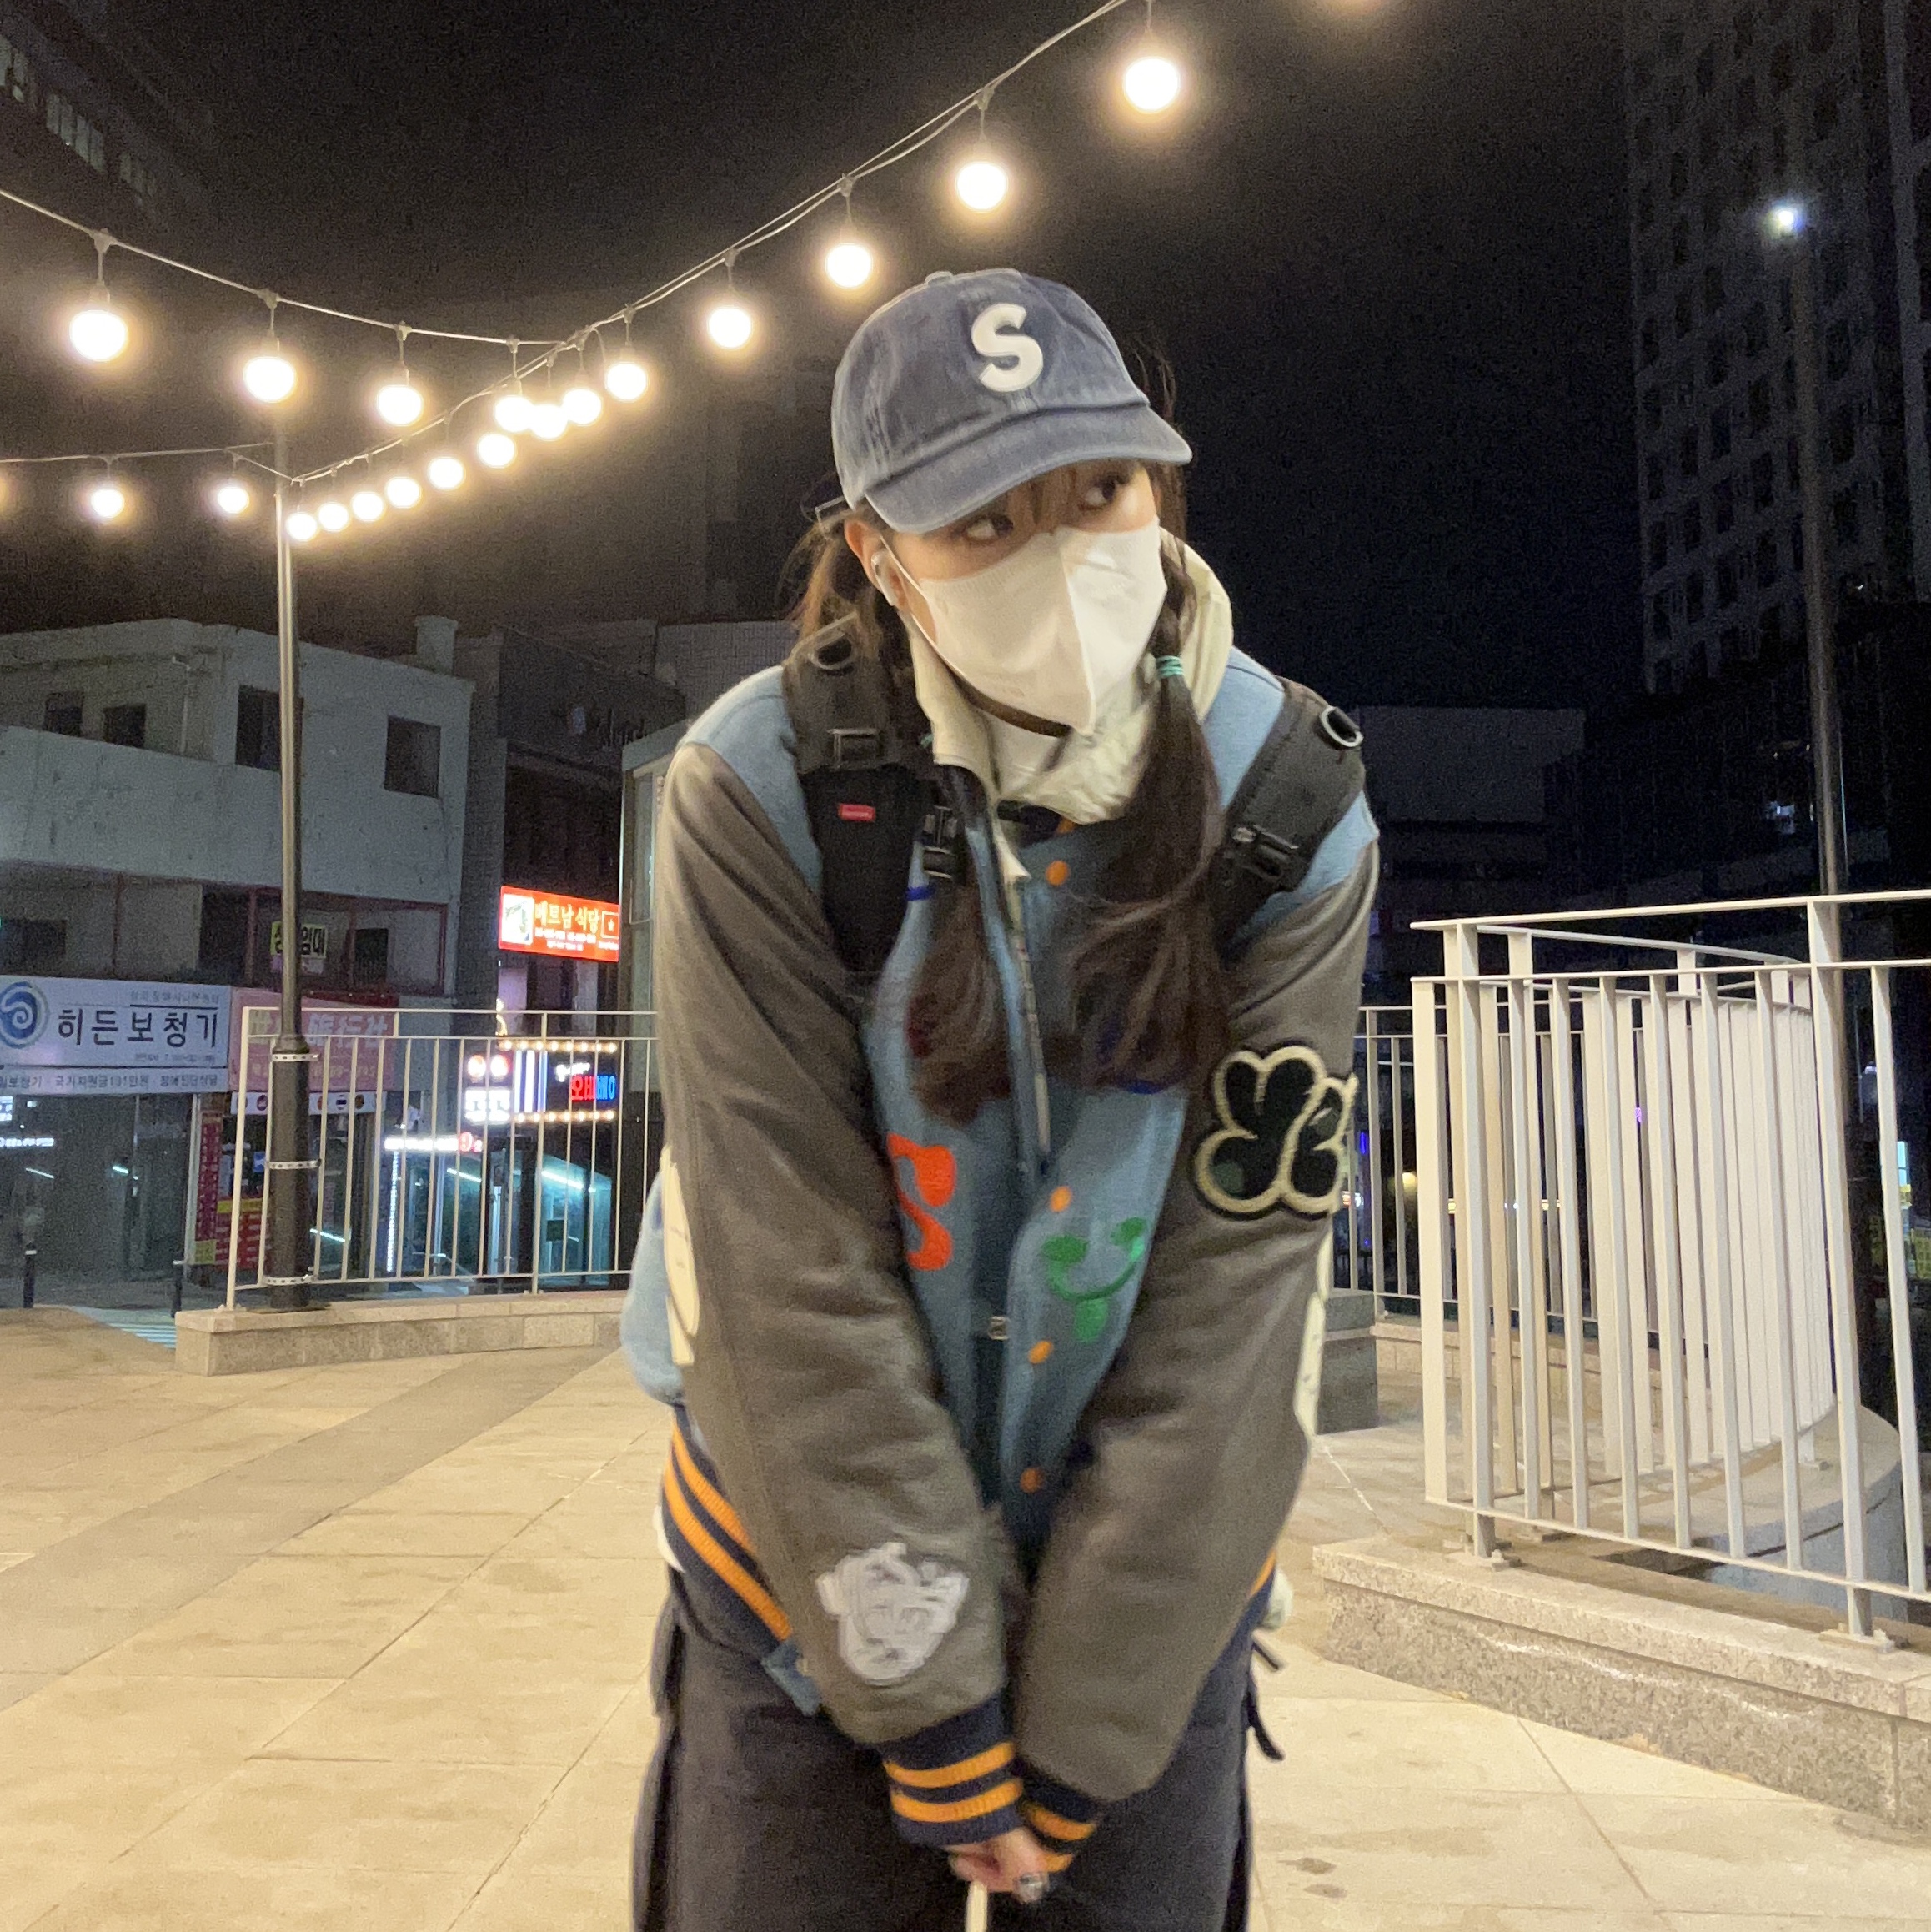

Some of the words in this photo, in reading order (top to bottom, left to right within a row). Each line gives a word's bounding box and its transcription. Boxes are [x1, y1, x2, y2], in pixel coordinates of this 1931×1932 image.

[971, 303, 1044, 393] S
[534, 901, 574, 929] 베트남
[575, 906, 600, 934] 식당
[58, 1007, 218, 1048] 히든보청기
